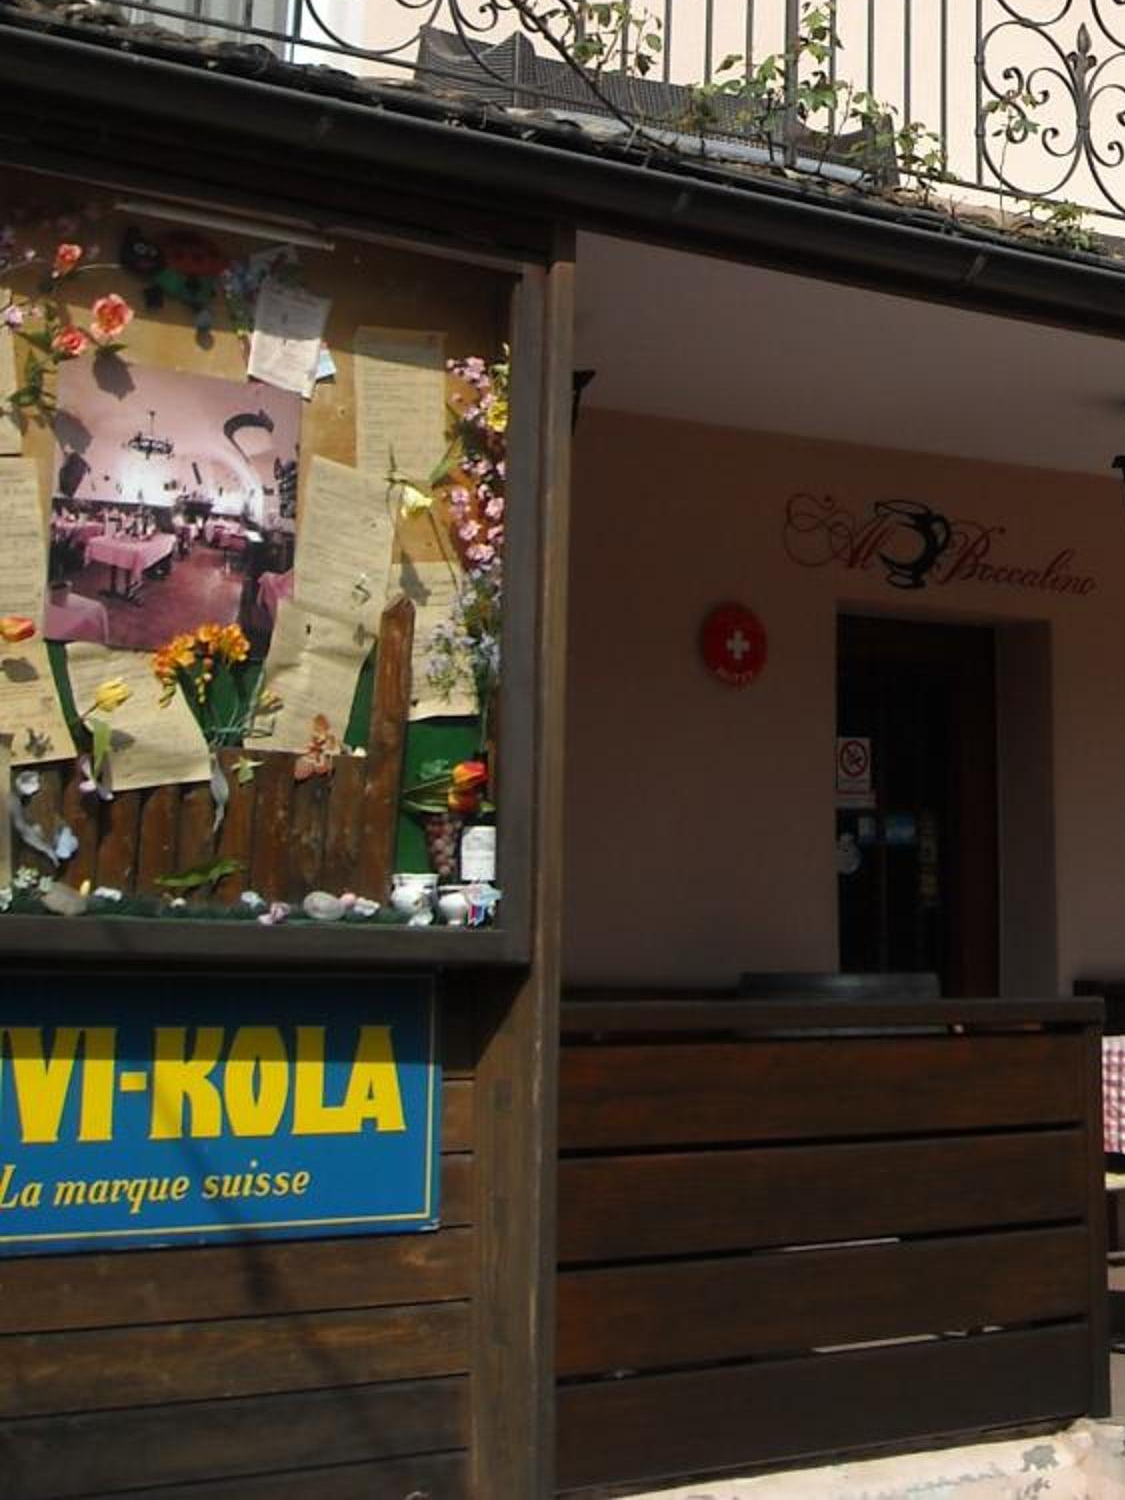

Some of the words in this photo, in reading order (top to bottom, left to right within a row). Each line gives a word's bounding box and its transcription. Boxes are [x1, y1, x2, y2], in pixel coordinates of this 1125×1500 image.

[931, 518, 1098, 597] Boccalino
[0, 1026, 406, 1143] VI-KOLA
[0, 1164, 43, 1209] La
[53, 1172, 190, 1214] marque
[202, 1159, 311, 1199] suisse
